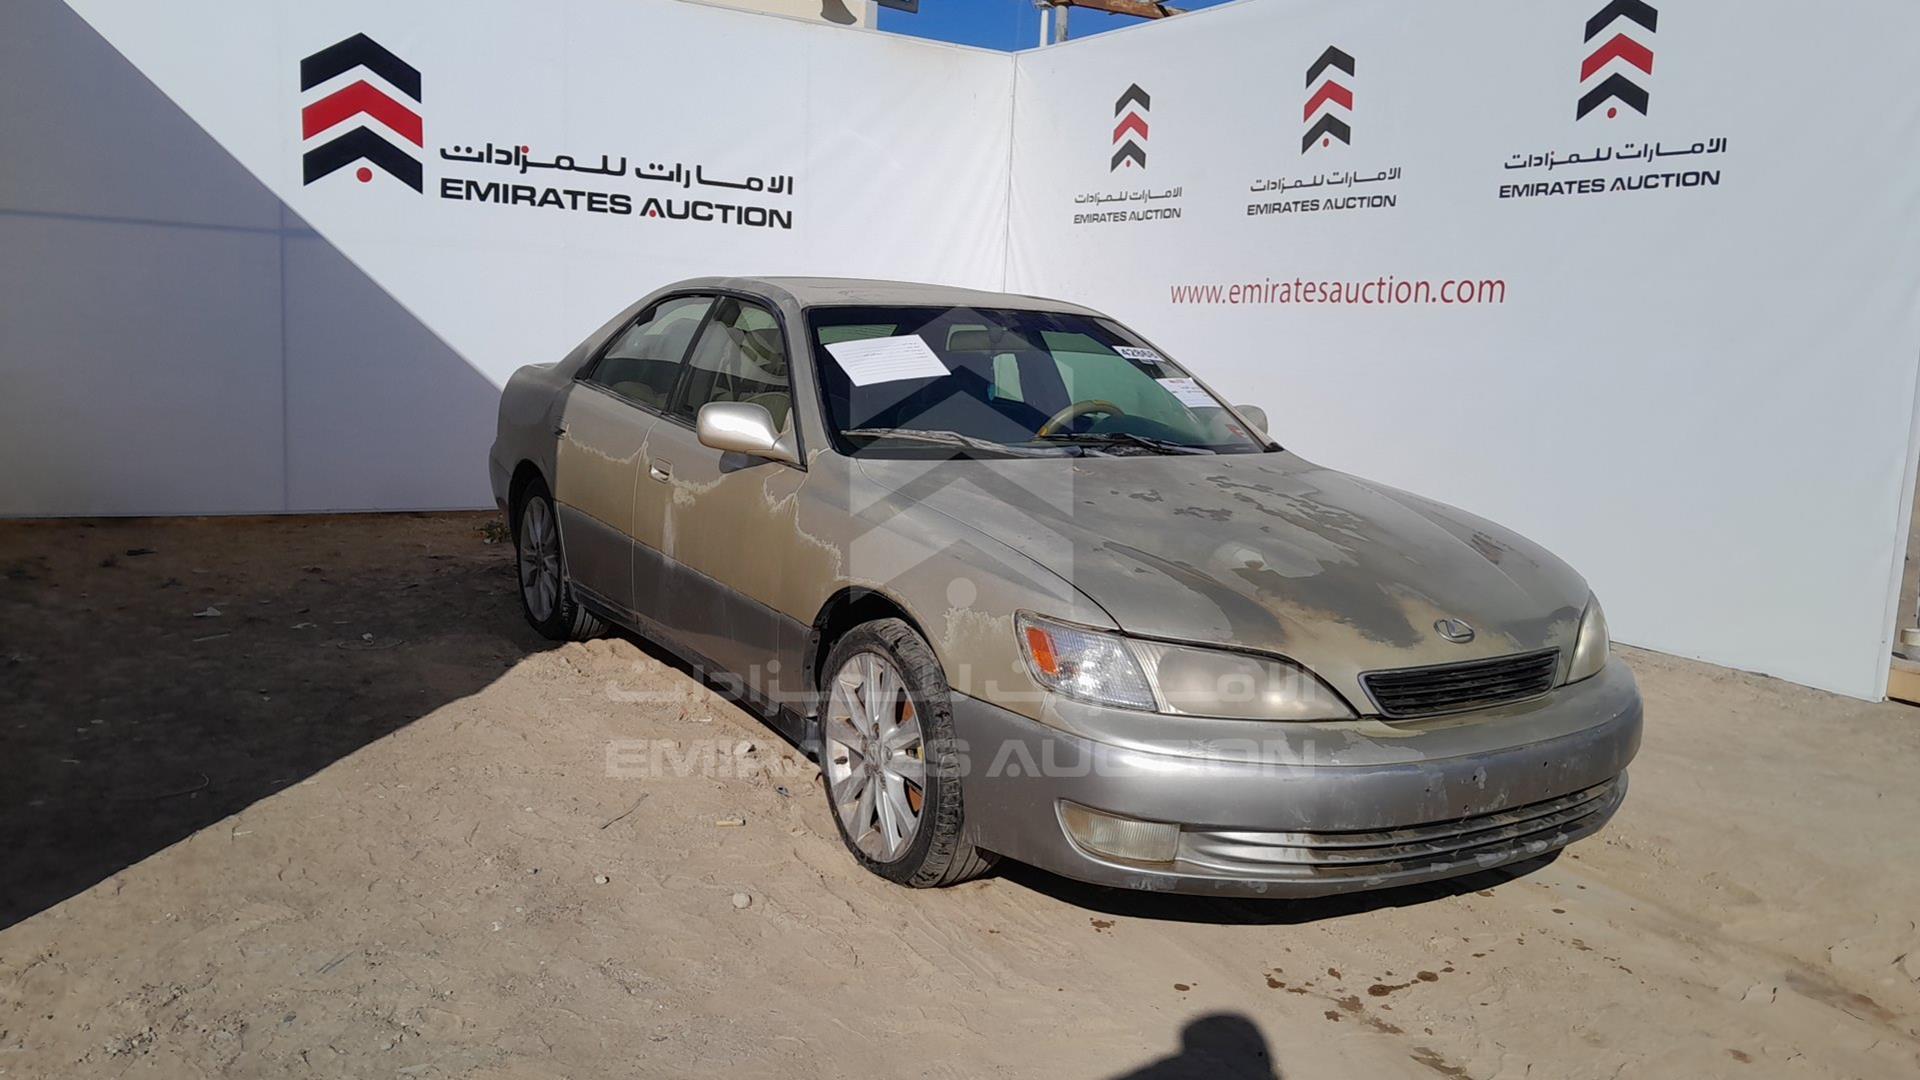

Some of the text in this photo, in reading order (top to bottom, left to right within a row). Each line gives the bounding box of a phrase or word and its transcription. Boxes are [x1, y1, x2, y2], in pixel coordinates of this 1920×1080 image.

[1498, 170, 1721, 199] EMIRATES AUCTION
[440, 177, 793, 230] EMIRATES AUCTION
[1073, 207, 1182, 225] EMIRATES AUCTION
[1247, 194, 1397, 216] EMIRATES AUCTION
[1170, 274, 1506, 304] www.emiratesauction.com
